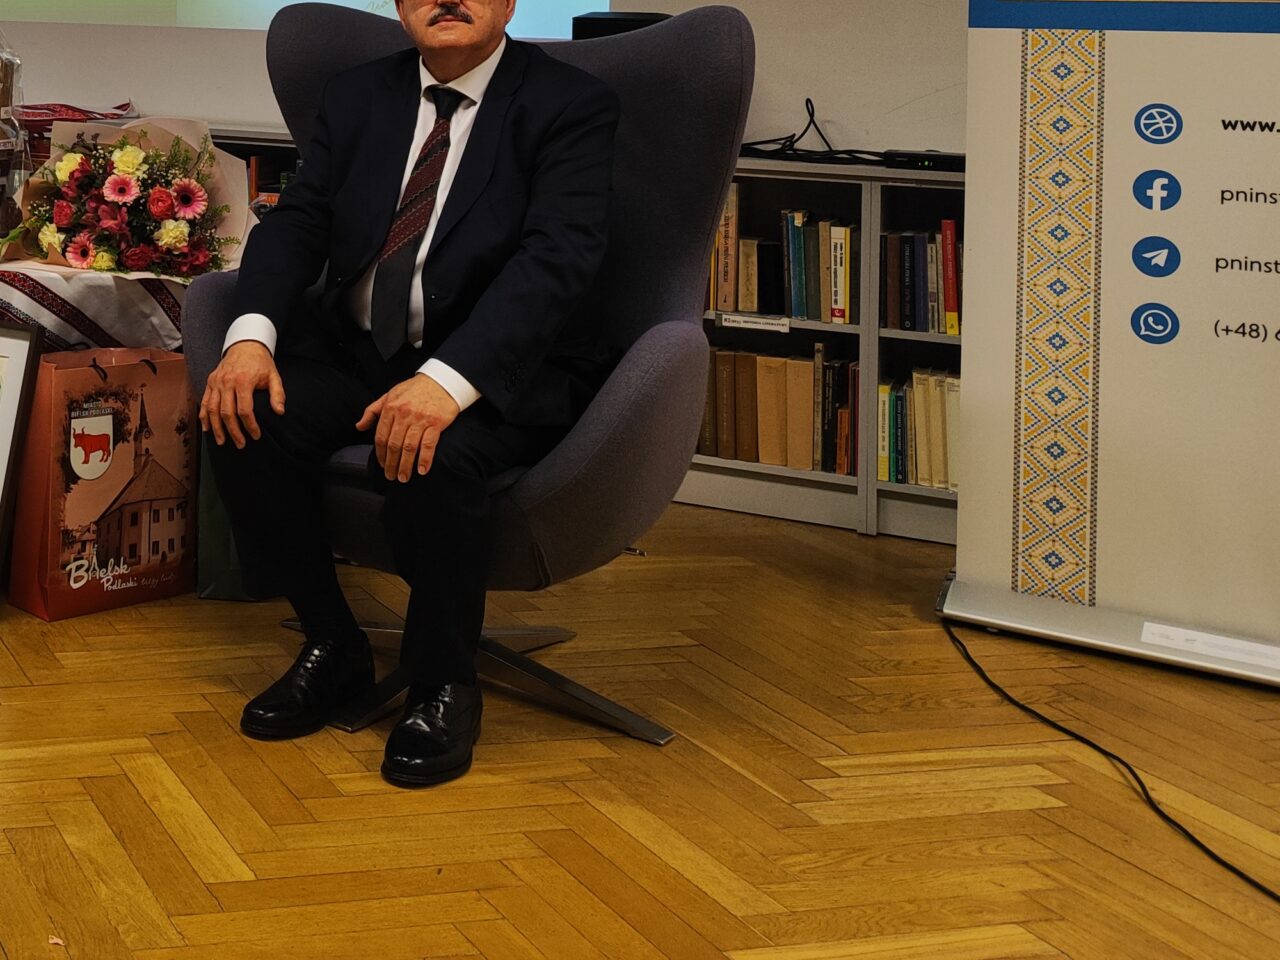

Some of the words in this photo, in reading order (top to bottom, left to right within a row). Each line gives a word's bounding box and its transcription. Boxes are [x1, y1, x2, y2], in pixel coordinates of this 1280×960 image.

[1221, 119, 1280, 133] www.
[1221, 187, 1280, 205] pnins
[1214, 319, 1268, 343] (+48)
[100, 576, 138, 591] Podlaski
